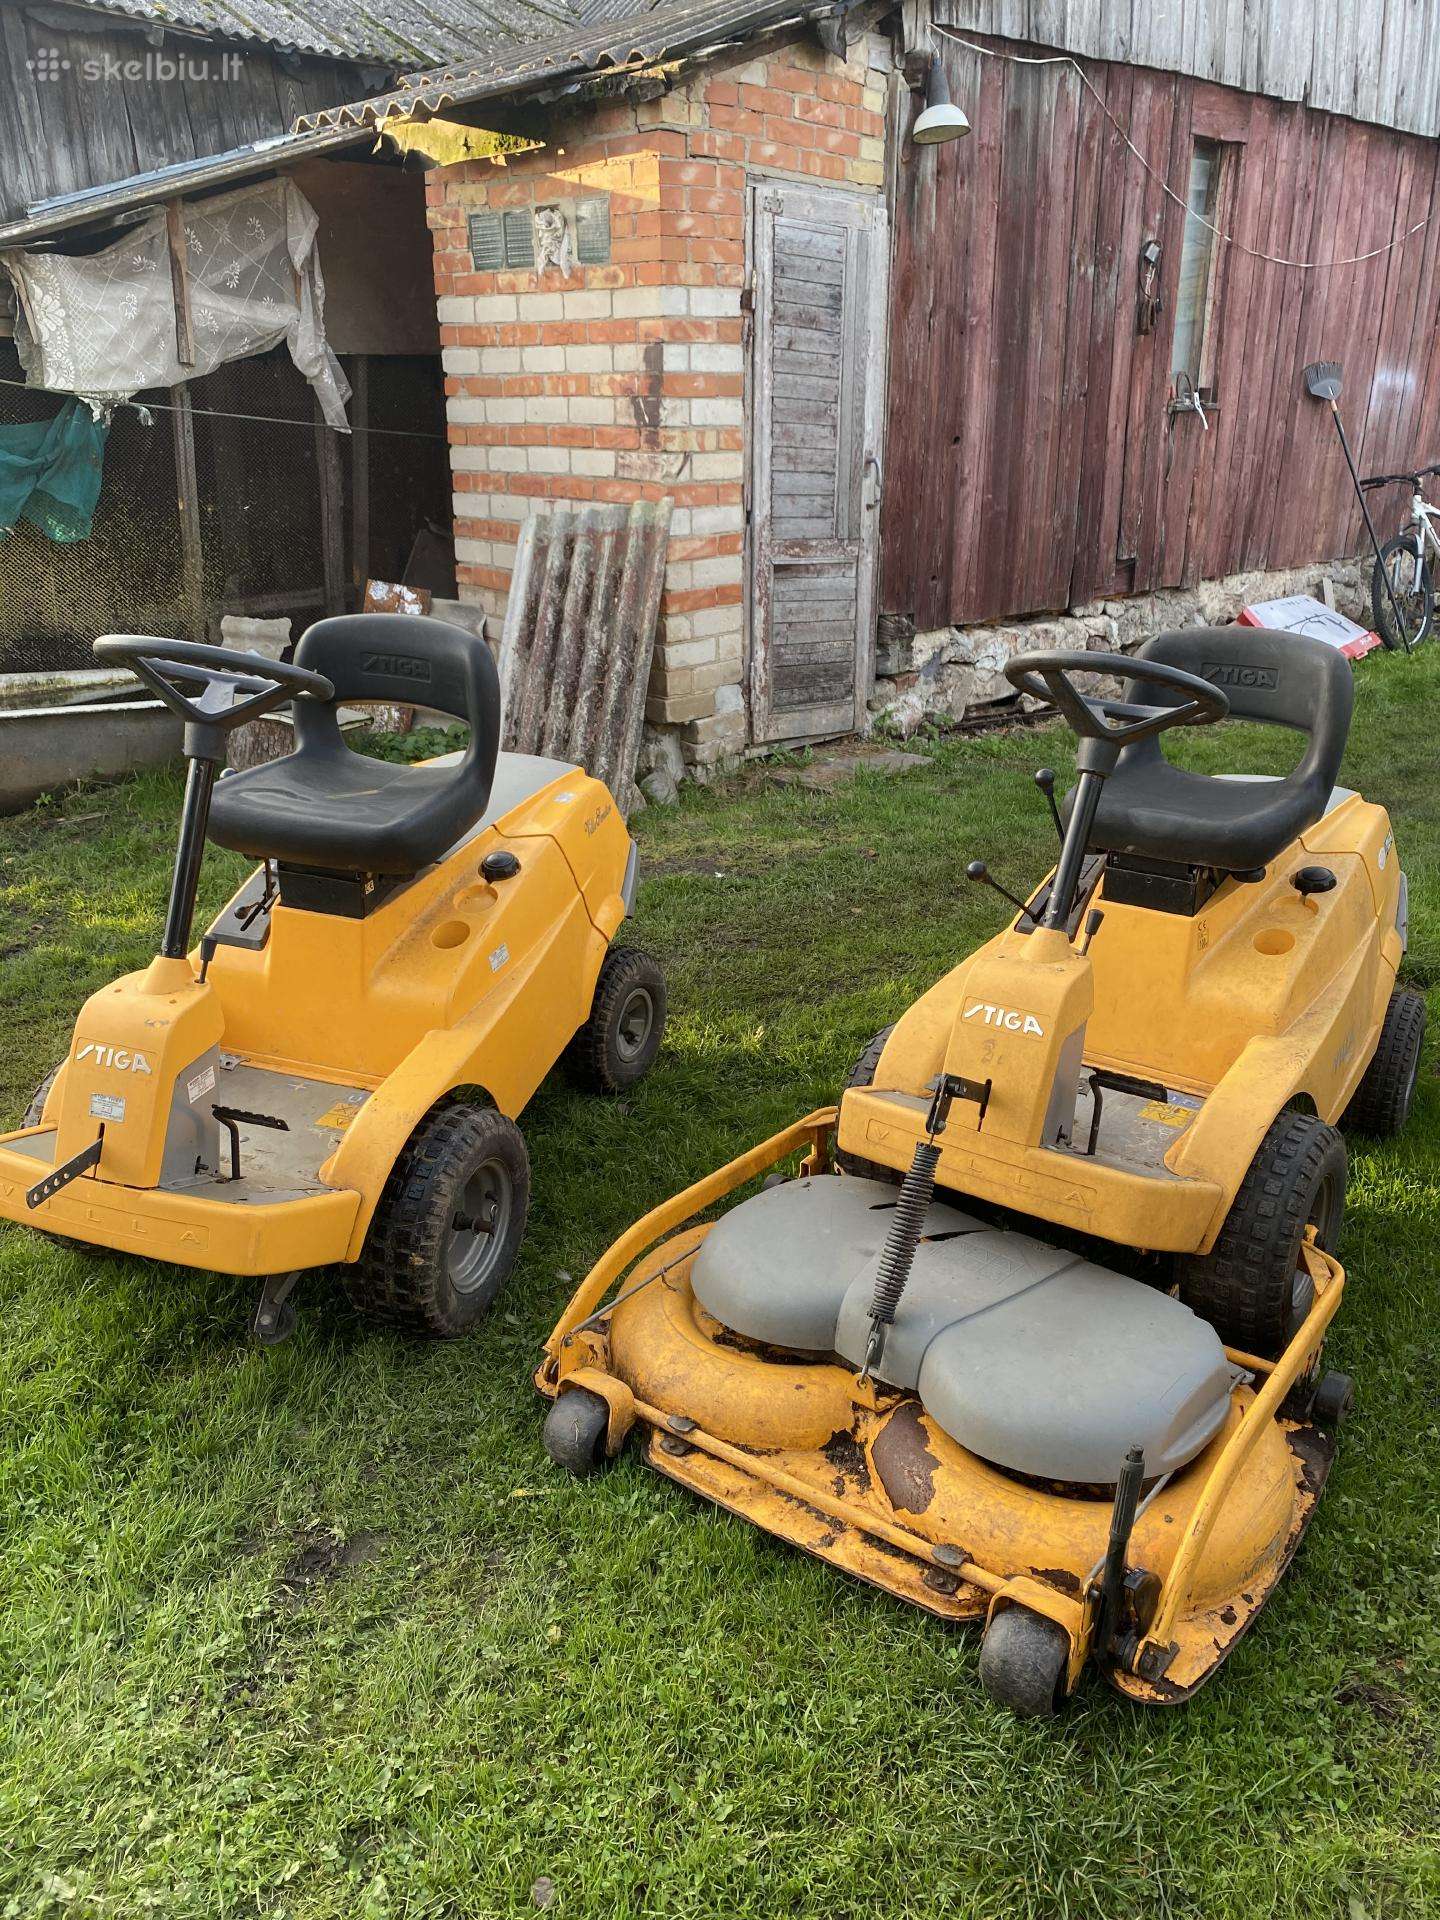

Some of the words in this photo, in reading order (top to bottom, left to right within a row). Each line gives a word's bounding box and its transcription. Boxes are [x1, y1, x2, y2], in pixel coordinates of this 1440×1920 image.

[362, 655, 430, 682] STIGA
[1201, 665, 1276, 688] STIGA
[963, 1003, 1045, 1037] STIGA
[75, 1043, 153, 1074] STIGA
